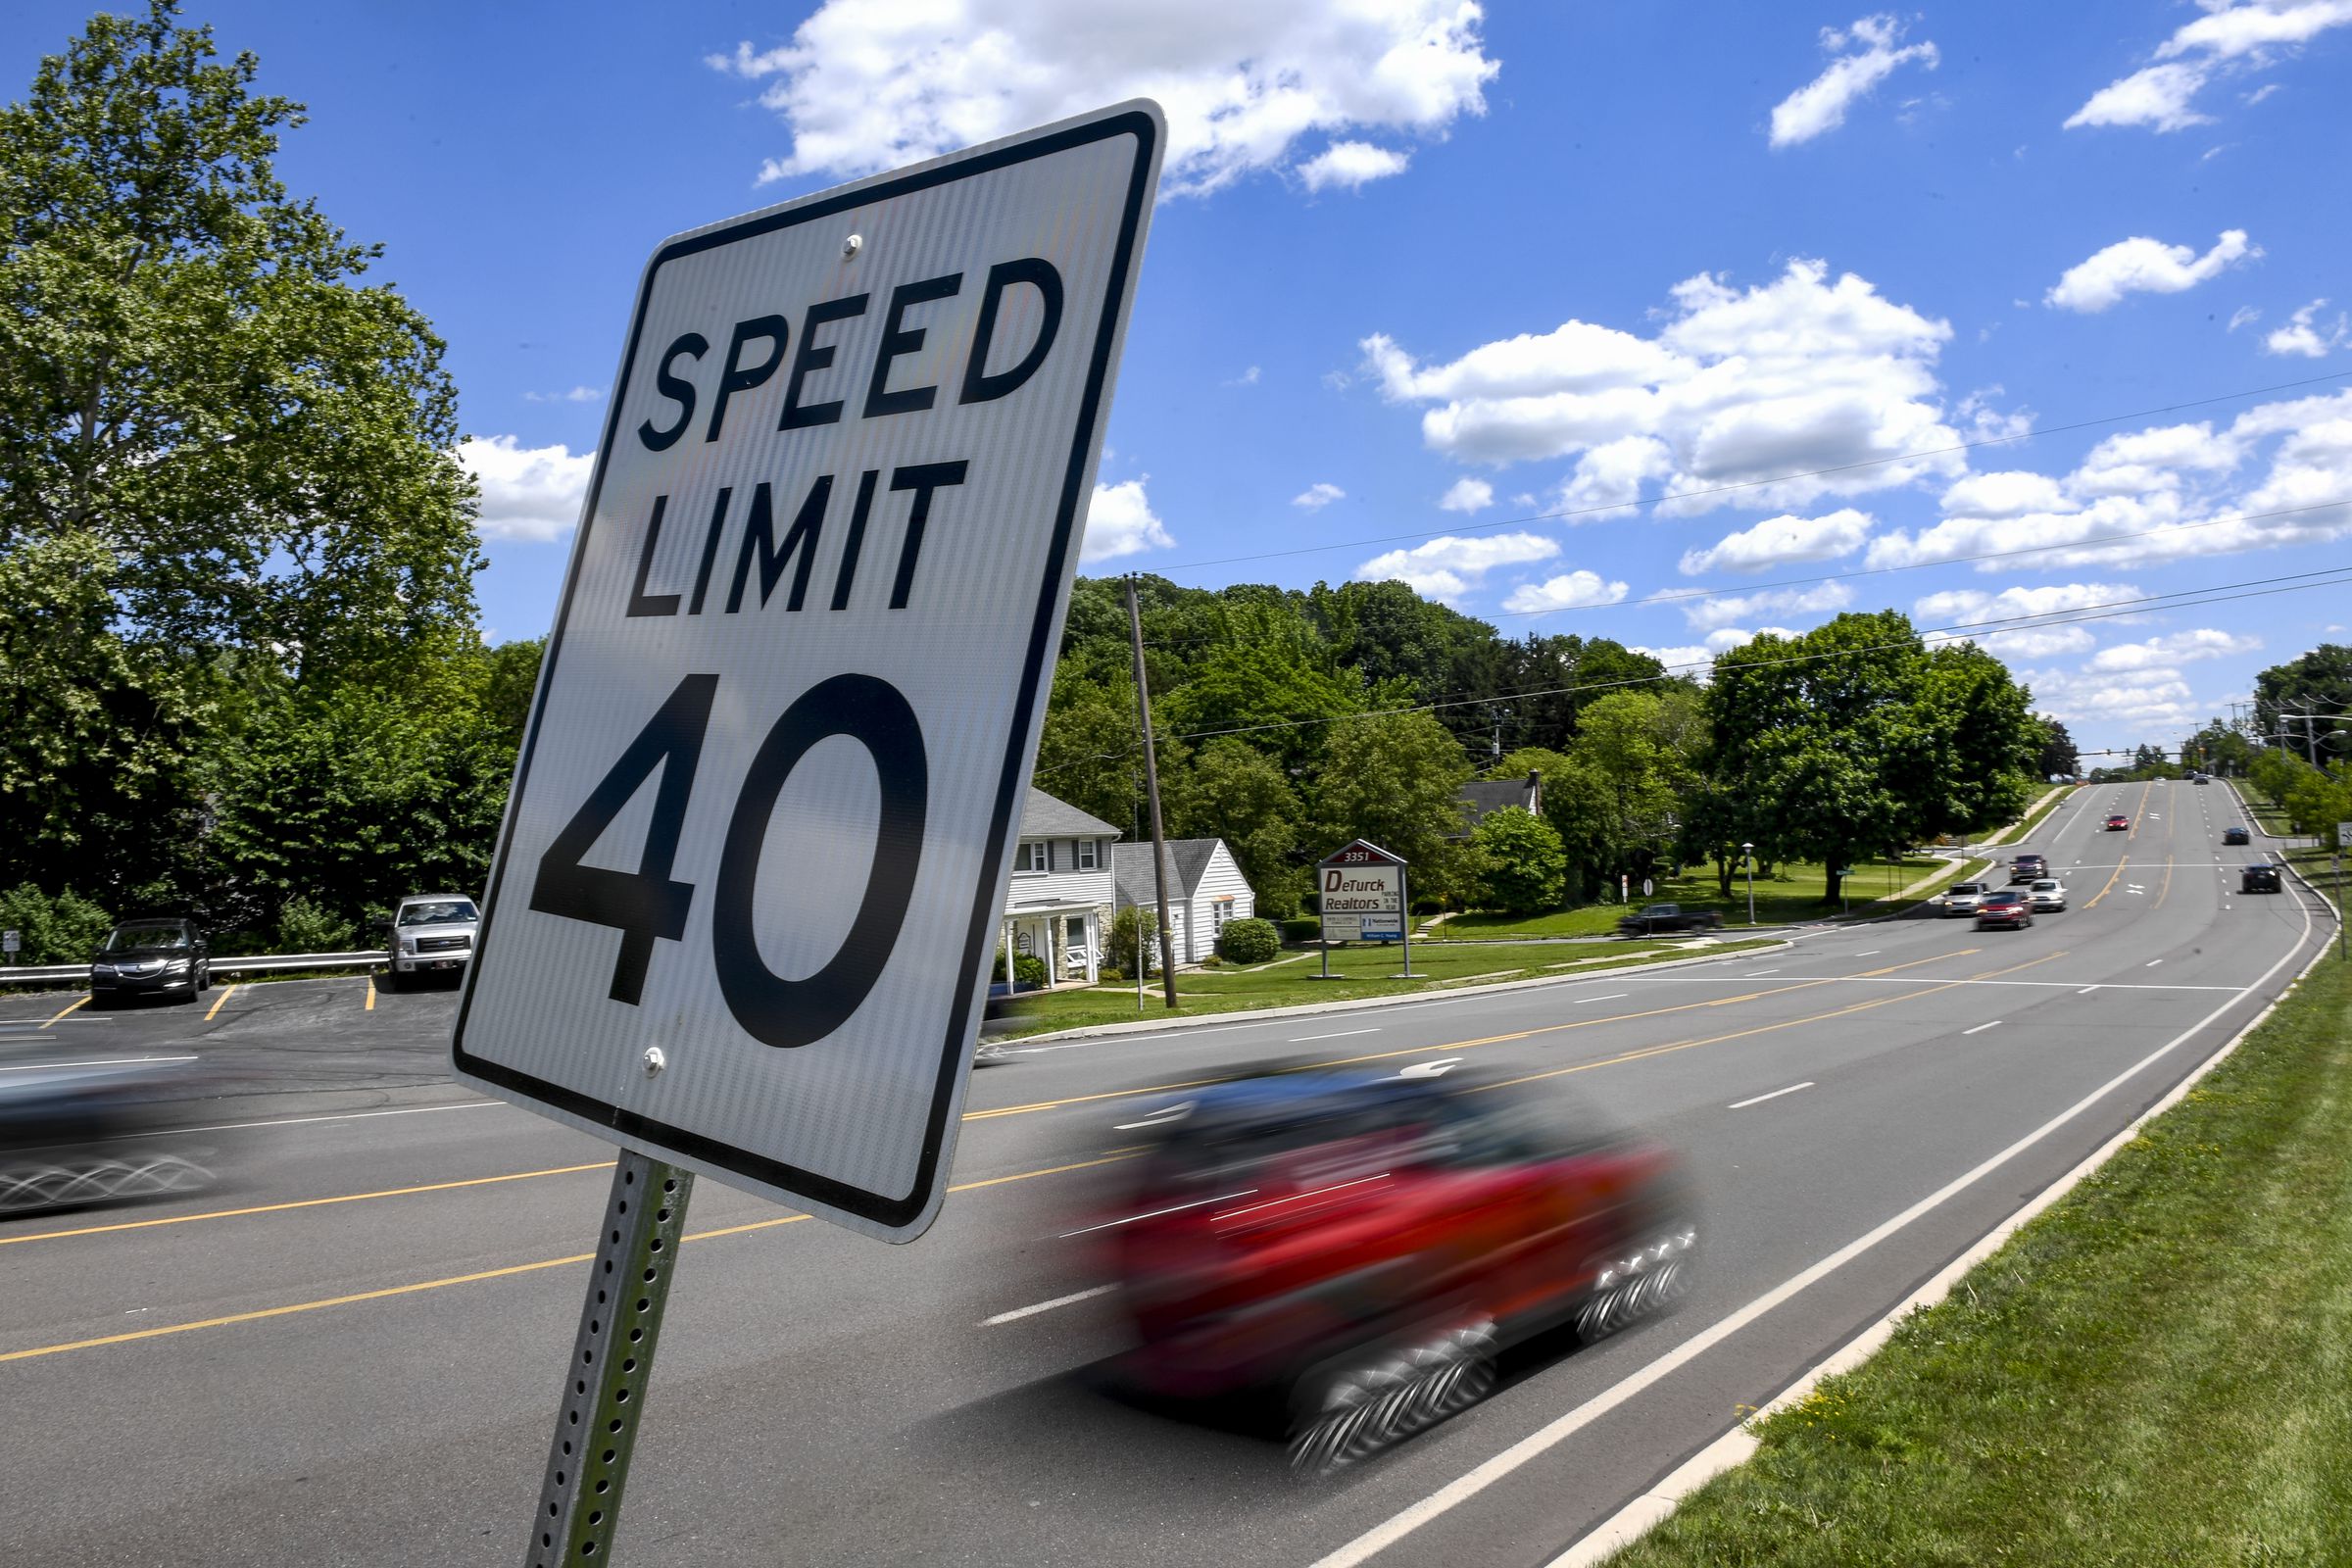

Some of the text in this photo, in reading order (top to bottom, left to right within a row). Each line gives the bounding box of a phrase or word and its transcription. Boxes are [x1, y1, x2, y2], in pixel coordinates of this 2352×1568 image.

[638, 257, 1065, 453] SPEED
[626, 459, 970, 618] LIMIT
[528, 672, 929, 1049] 40
[1325, 870, 1385, 892] DeTurck
[1345, 853, 1369, 862] 3351
[1326, 898, 1379, 909] Realtors
